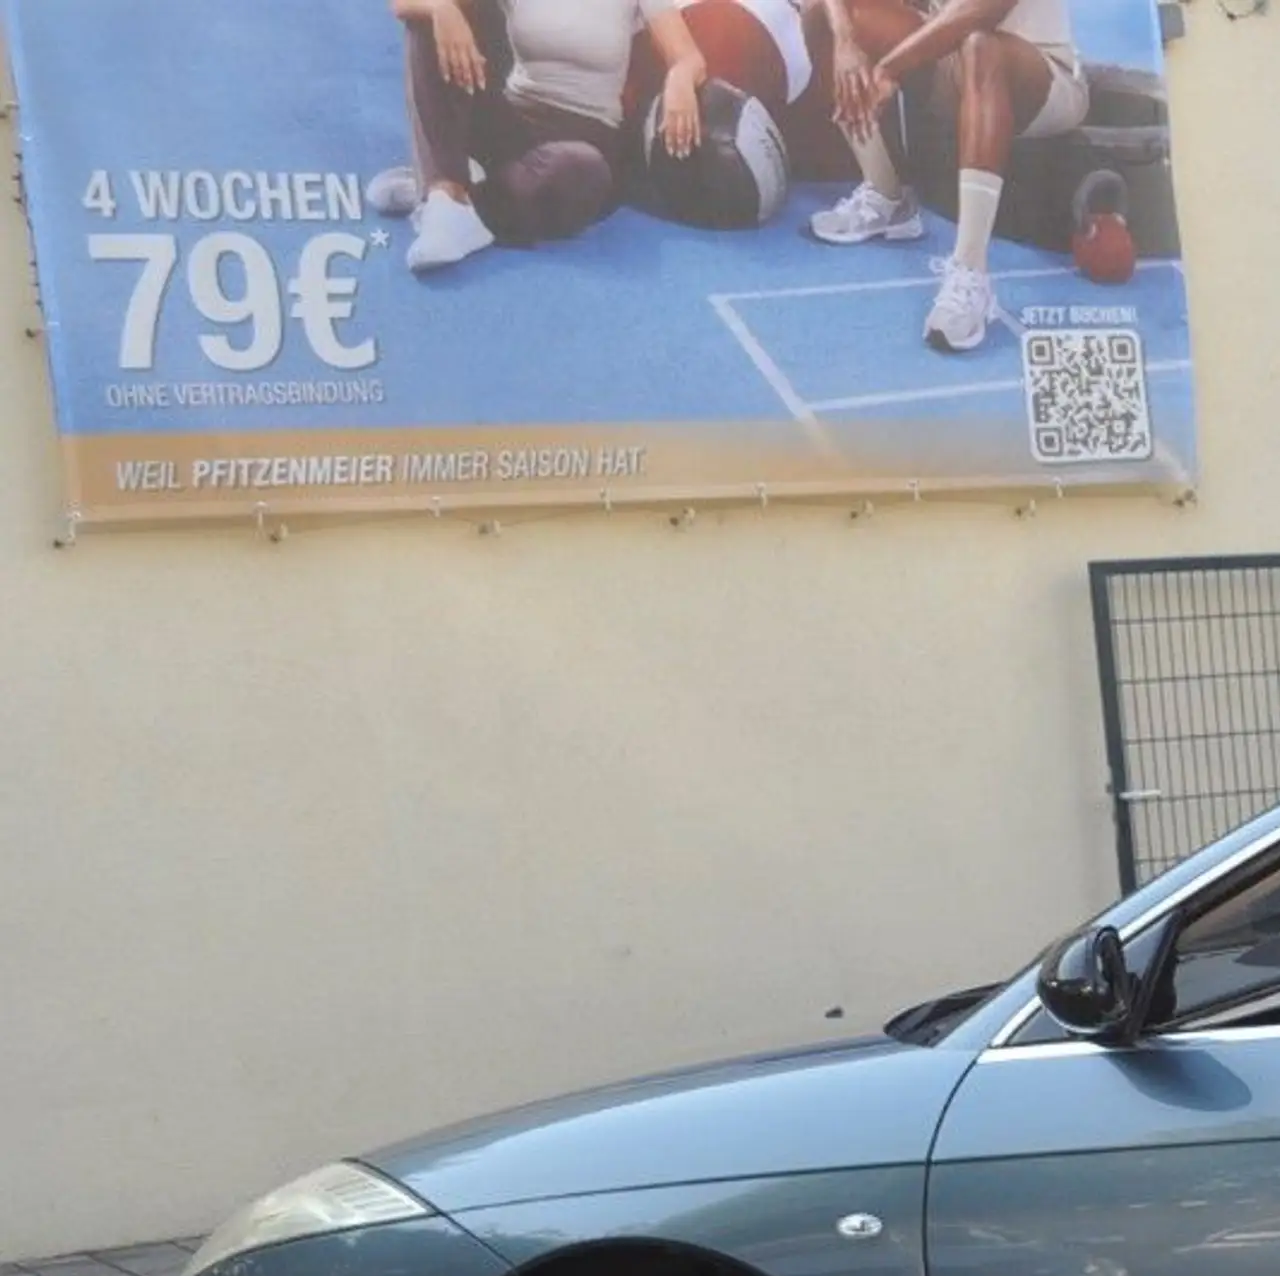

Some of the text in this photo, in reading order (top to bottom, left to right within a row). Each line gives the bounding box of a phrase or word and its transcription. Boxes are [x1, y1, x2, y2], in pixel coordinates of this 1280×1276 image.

[82, 169, 363, 221] 4 WOCHEN
[105, 379, 384, 407] OHNE VERTRAGSBINDUNG
[116, 460, 181, 491] WEIL
[191, 453, 393, 488] PFITZENMEIER
[402, 451, 489, 483] IMMER
[496, 448, 591, 480] SAISON
